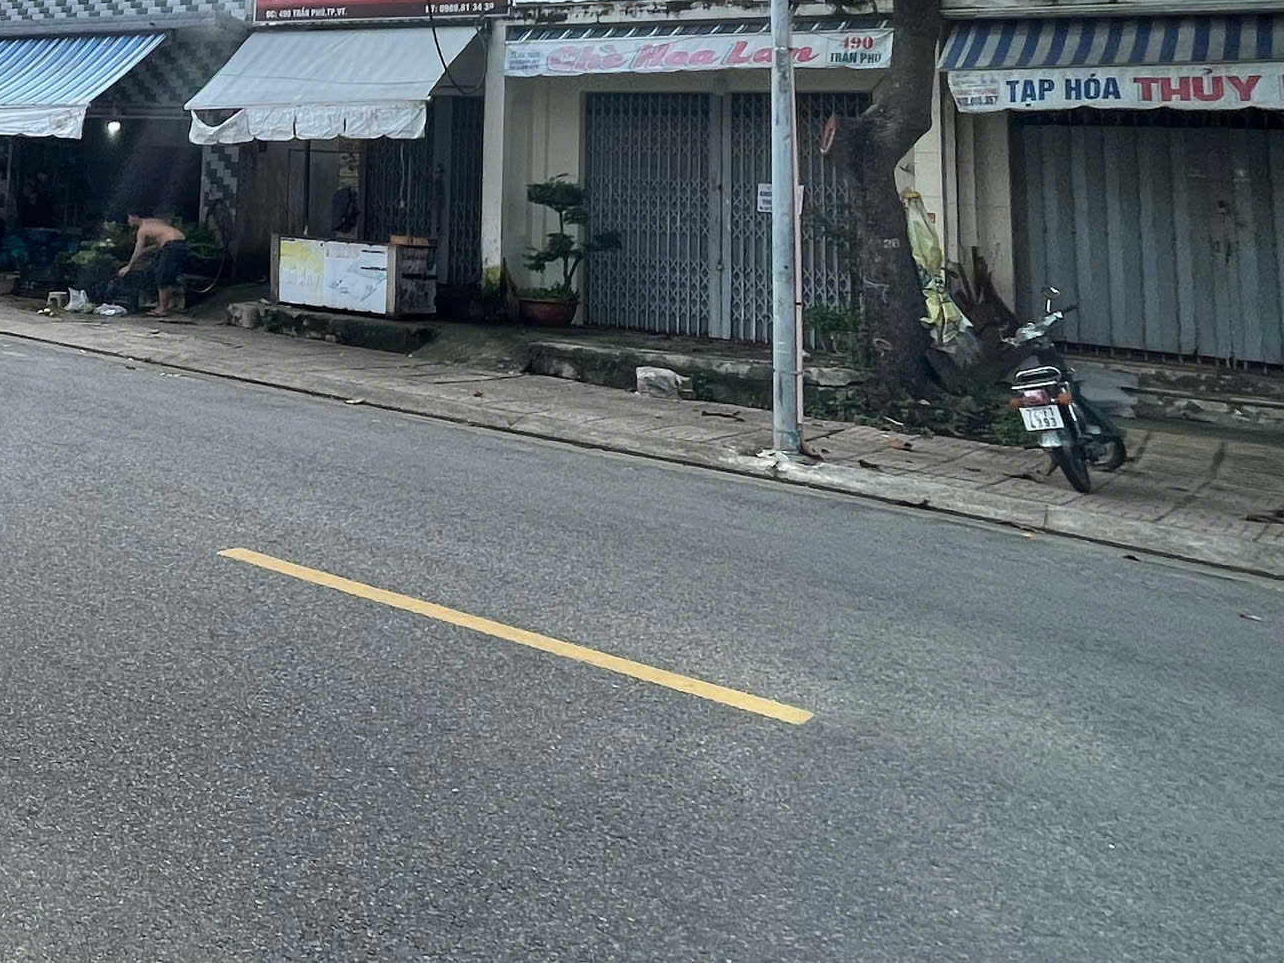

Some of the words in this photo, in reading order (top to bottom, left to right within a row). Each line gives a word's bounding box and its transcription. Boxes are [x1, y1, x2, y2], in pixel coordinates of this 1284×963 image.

[629, 43, 720, 70] Hoa
[720, 40, 820, 66] Lan
[1005, 78, 1055, 107] TẠP
[1065, 73, 1122, 101] HÓA
[1133, 67, 1262, 102] THỦY
